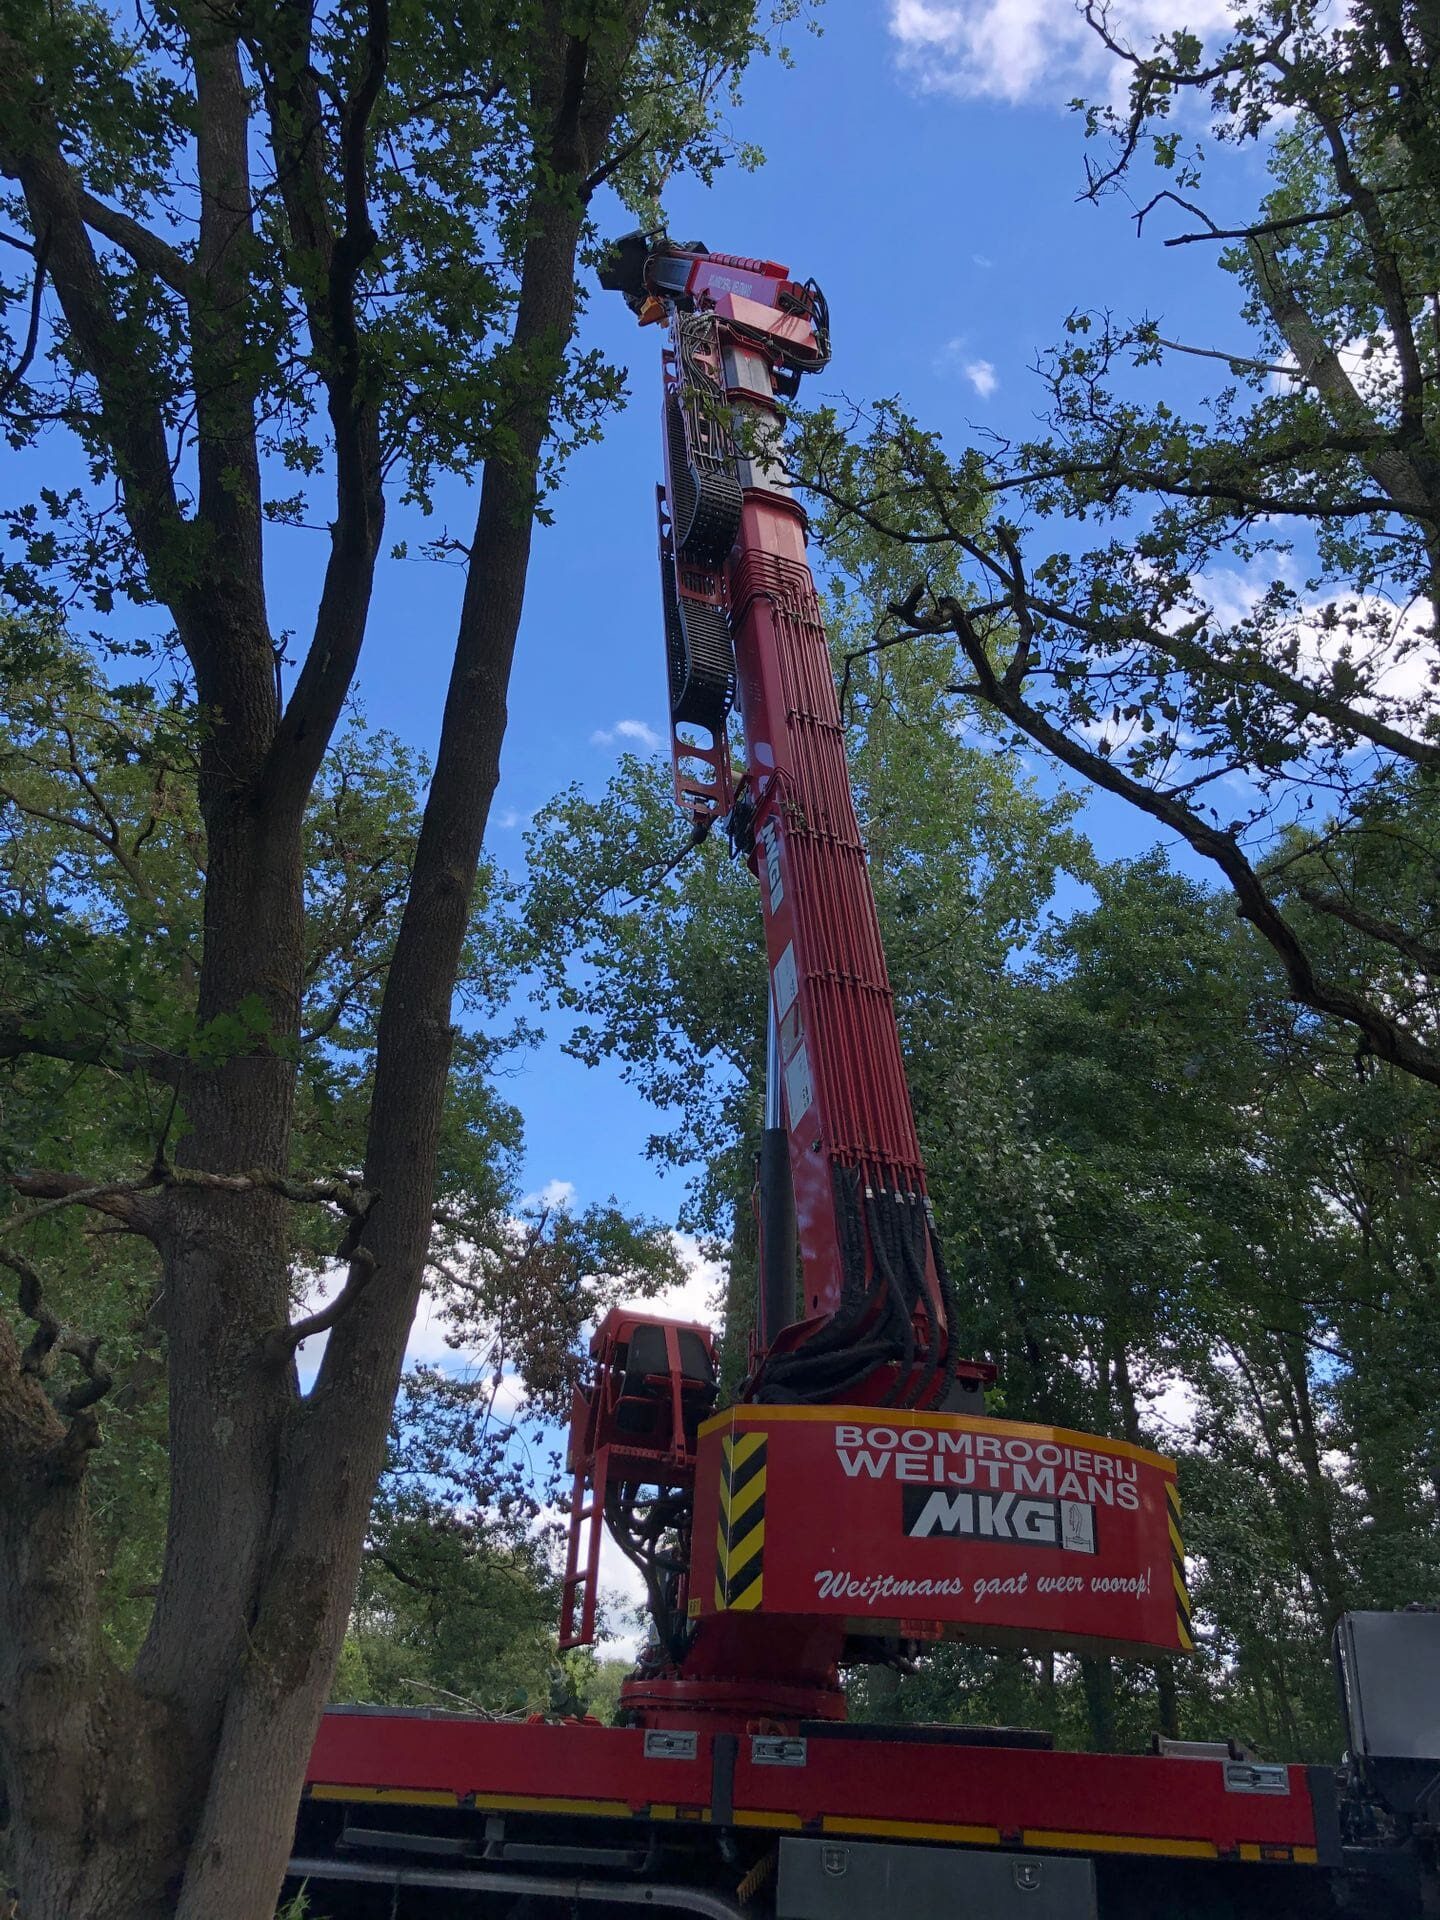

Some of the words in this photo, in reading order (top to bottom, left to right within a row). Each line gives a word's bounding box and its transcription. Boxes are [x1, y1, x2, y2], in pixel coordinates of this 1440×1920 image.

[762, 821, 781, 892] MKG
[835, 1425, 1138, 1482] BOOMROOIERIJ
[835, 1449, 1139, 1509] WEIJTMANS
[909, 1491, 1056, 1543] MKG
[814, 1570, 964, 1604] Weijtmans
[973, 1572, 1028, 1604] gaat
[1037, 1575, 1085, 1593] weer
[1090, 1567, 1151, 1600] voorop!
